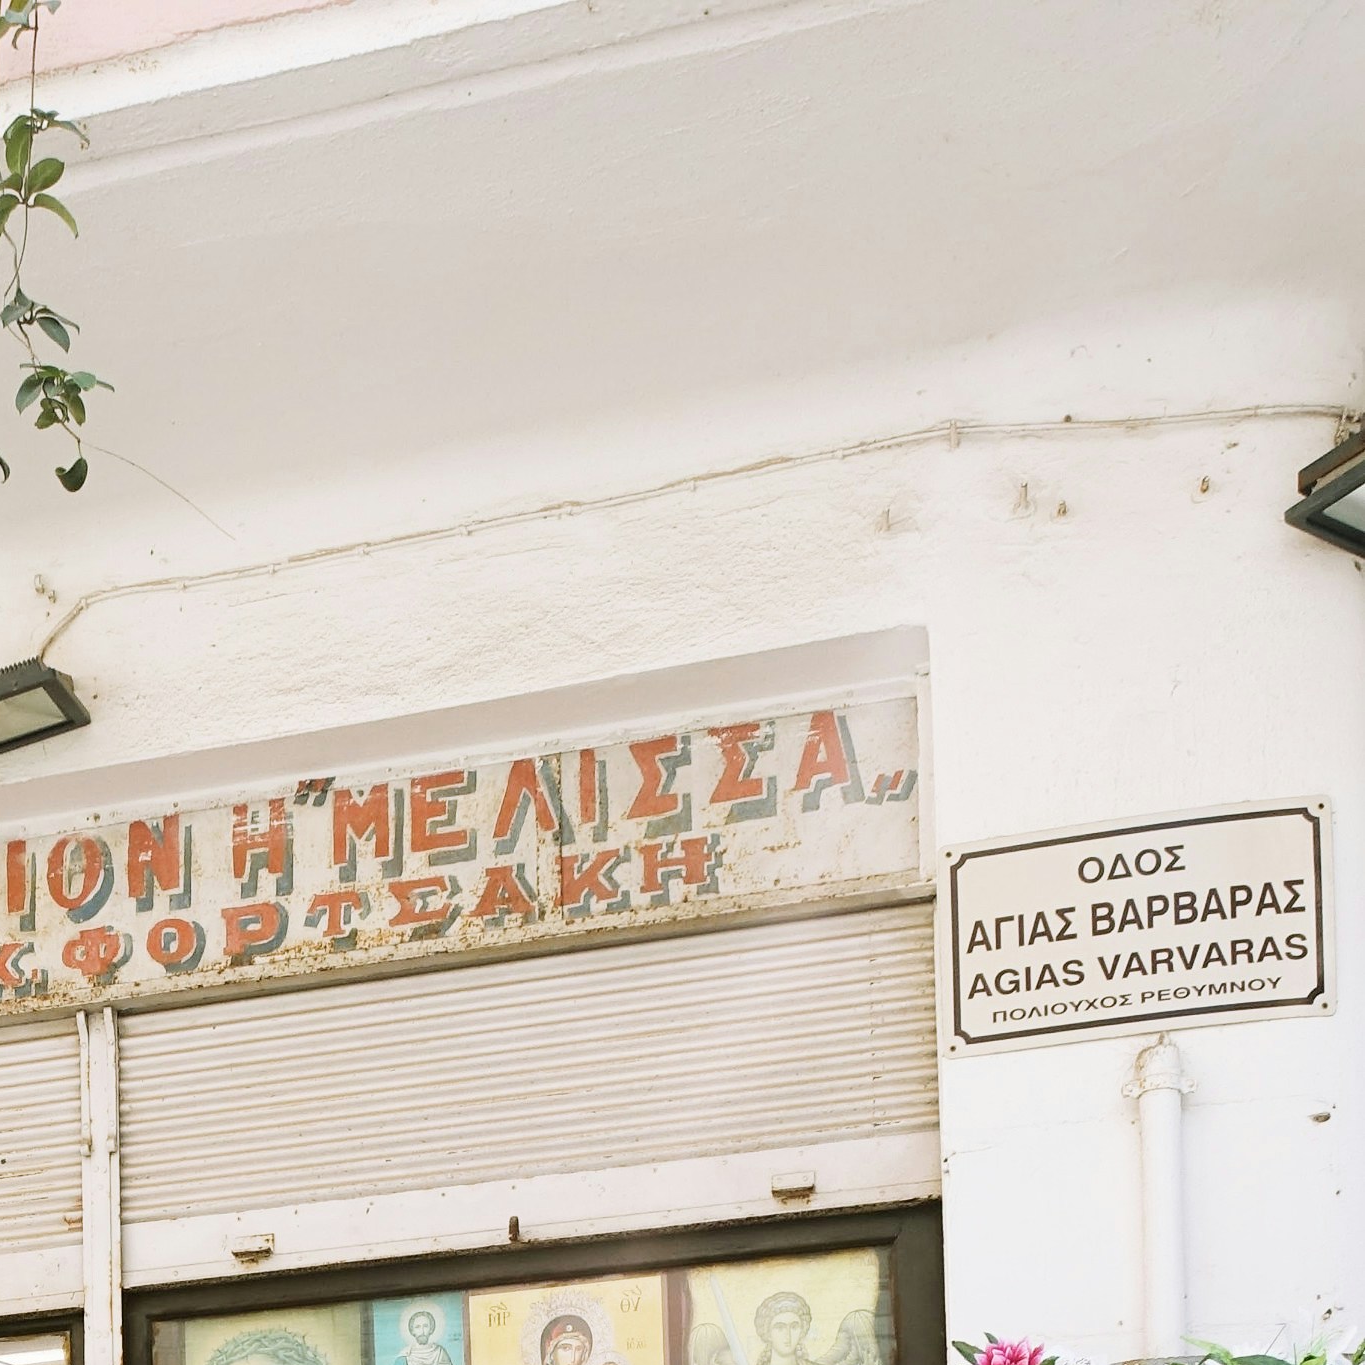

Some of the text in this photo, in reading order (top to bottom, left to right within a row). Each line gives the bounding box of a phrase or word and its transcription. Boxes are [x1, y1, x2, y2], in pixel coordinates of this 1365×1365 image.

[1078, 845, 1186, 884] ΟΔΟΣ
[62, 832, 724, 984] ΦΟΡΤΣΑΚΗ
[966, 879, 1306, 954] ΑΓΙΑΣ ΒΑΡΒΑΡΑΣ
[967, 933, 1308, 999] AGIAS VARVARAS
[993, 976, 1283, 1024] ΠΟΛΙΟΥΧΟΣ ΡΕΘΥΜΝΟΥ
